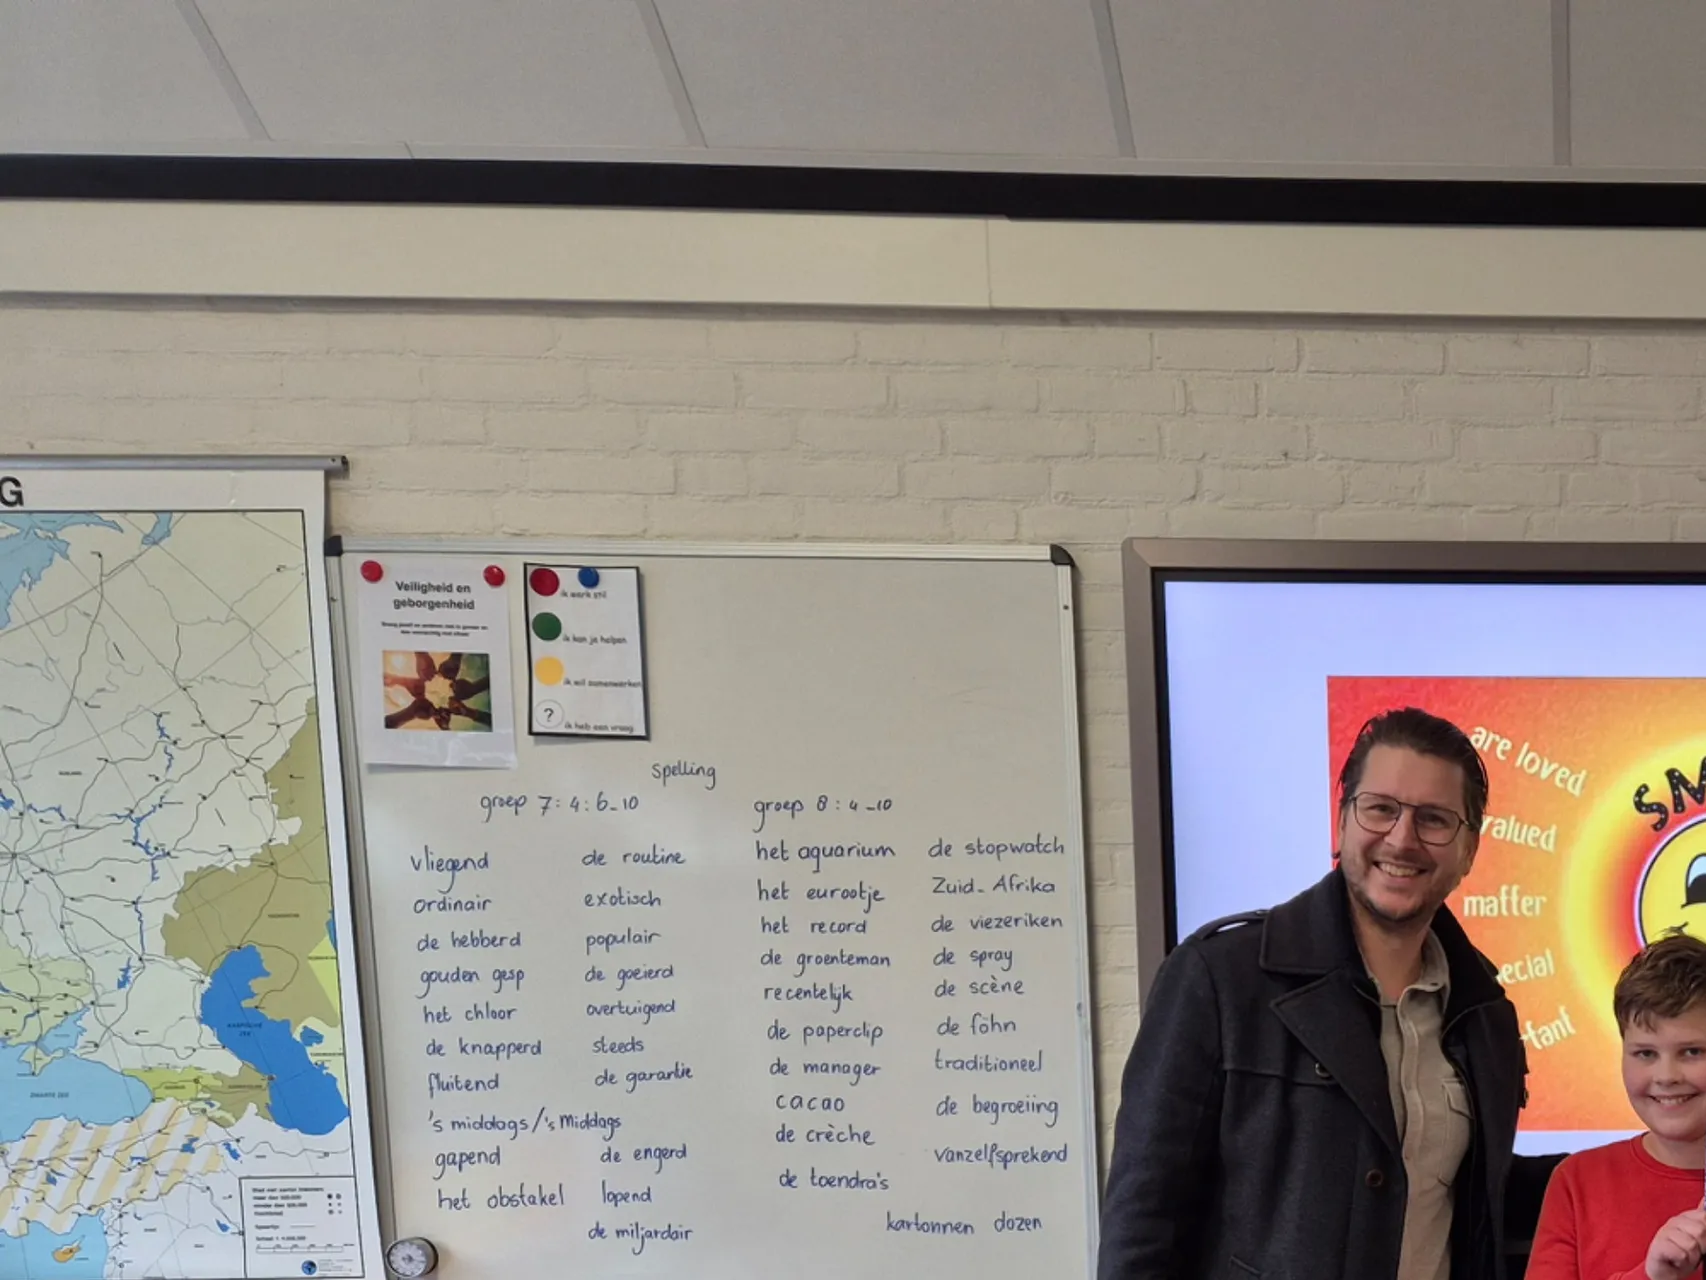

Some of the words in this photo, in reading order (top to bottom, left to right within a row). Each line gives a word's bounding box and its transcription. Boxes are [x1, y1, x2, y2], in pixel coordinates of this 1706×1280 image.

[0, 476, 24, 508] G
[395, 581, 453, 594] Veiligheid
[456, 584, 471, 593] en
[393, 597, 475, 611] geborgenheid
[543, 708, 555, 723] ?
[1470, 725, 1513, 761] are
[1516, 742, 1587, 798] loved
[651, 760, 717, 791] spelling
[480, 794, 527, 823] groep
[753, 797, 804, 833] groep
[582, 849, 606, 867] de
[622, 843, 686, 866] routine
[755, 839, 789, 861] het
[798, 843, 896, 873] aquarium
[927, 838, 953, 857] de
[965, 832, 1065, 861] stopwatch
[410, 845, 489, 894] vliegend
[584, 886, 662, 908] exotisch
[757, 878, 789, 901] het
[1463, 884, 1546, 918] matter
[413, 895, 493, 914] ordinair
[760, 916, 789, 934] het
[810, 919, 867, 935] record
[931, 914, 954, 933] de
[417, 933, 439, 952] de
[450, 928, 522, 949] hebberd
[586, 927, 661, 956] populair
[760, 949, 782, 966] de
[793, 948, 891, 978] groenteman
[933, 947, 956, 966] de
[969, 949, 1013, 972] spray
[415, 966, 480, 999] gouden
[492, 968, 525, 994] gesp
[584, 967, 606, 983] de
[934, 979, 956, 998] de
[968, 974, 1025, 996] scène
[763, 982, 854, 1014] recentelijk
[423, 1005, 452, 1024] het
[465, 1001, 517, 1022] chloor
[586, 998, 676, 1025] overtuigend
[937, 1015, 960, 1036] de
[970, 1012, 1017, 1036] föhn
[592, 1036, 645, 1054] steeds
[766, 1020, 791, 1041] de
[802, 1021, 884, 1047] paperclip
[426, 1039, 446, 1056] de
[458, 1037, 542, 1060] knapperd
[935, 1049, 1042, 1072] traditioneel
[595, 1069, 618, 1087] de
[769, 1057, 788, 1076] de
[802, 1061, 882, 1086] manager
[427, 1072, 500, 1099] fluitend
[775, 1093, 845, 1111] cacao
[936, 1095, 957, 1116] de
[972, 1094, 1059, 1128] begroeiing
[775, 1123, 796, 1143] de
[806, 1123, 876, 1146] crèche
[432, 1146, 501, 1180] gapend
[600, 1145, 622, 1164] de
[633, 1143, 687, 1175] engerd
[934, 1142, 1068, 1170] vanzelfsprekend
[778, 1168, 799, 1188] de
[810, 1166, 890, 1191] toendra's
[438, 1188, 471, 1210] het
[487, 1182, 565, 1208] obstakel
[602, 1180, 653, 1205] lopend
[994, 1210, 1042, 1232] dozen
[588, 1221, 608, 1241] de
[615, 1221, 694, 1255] miljardair
